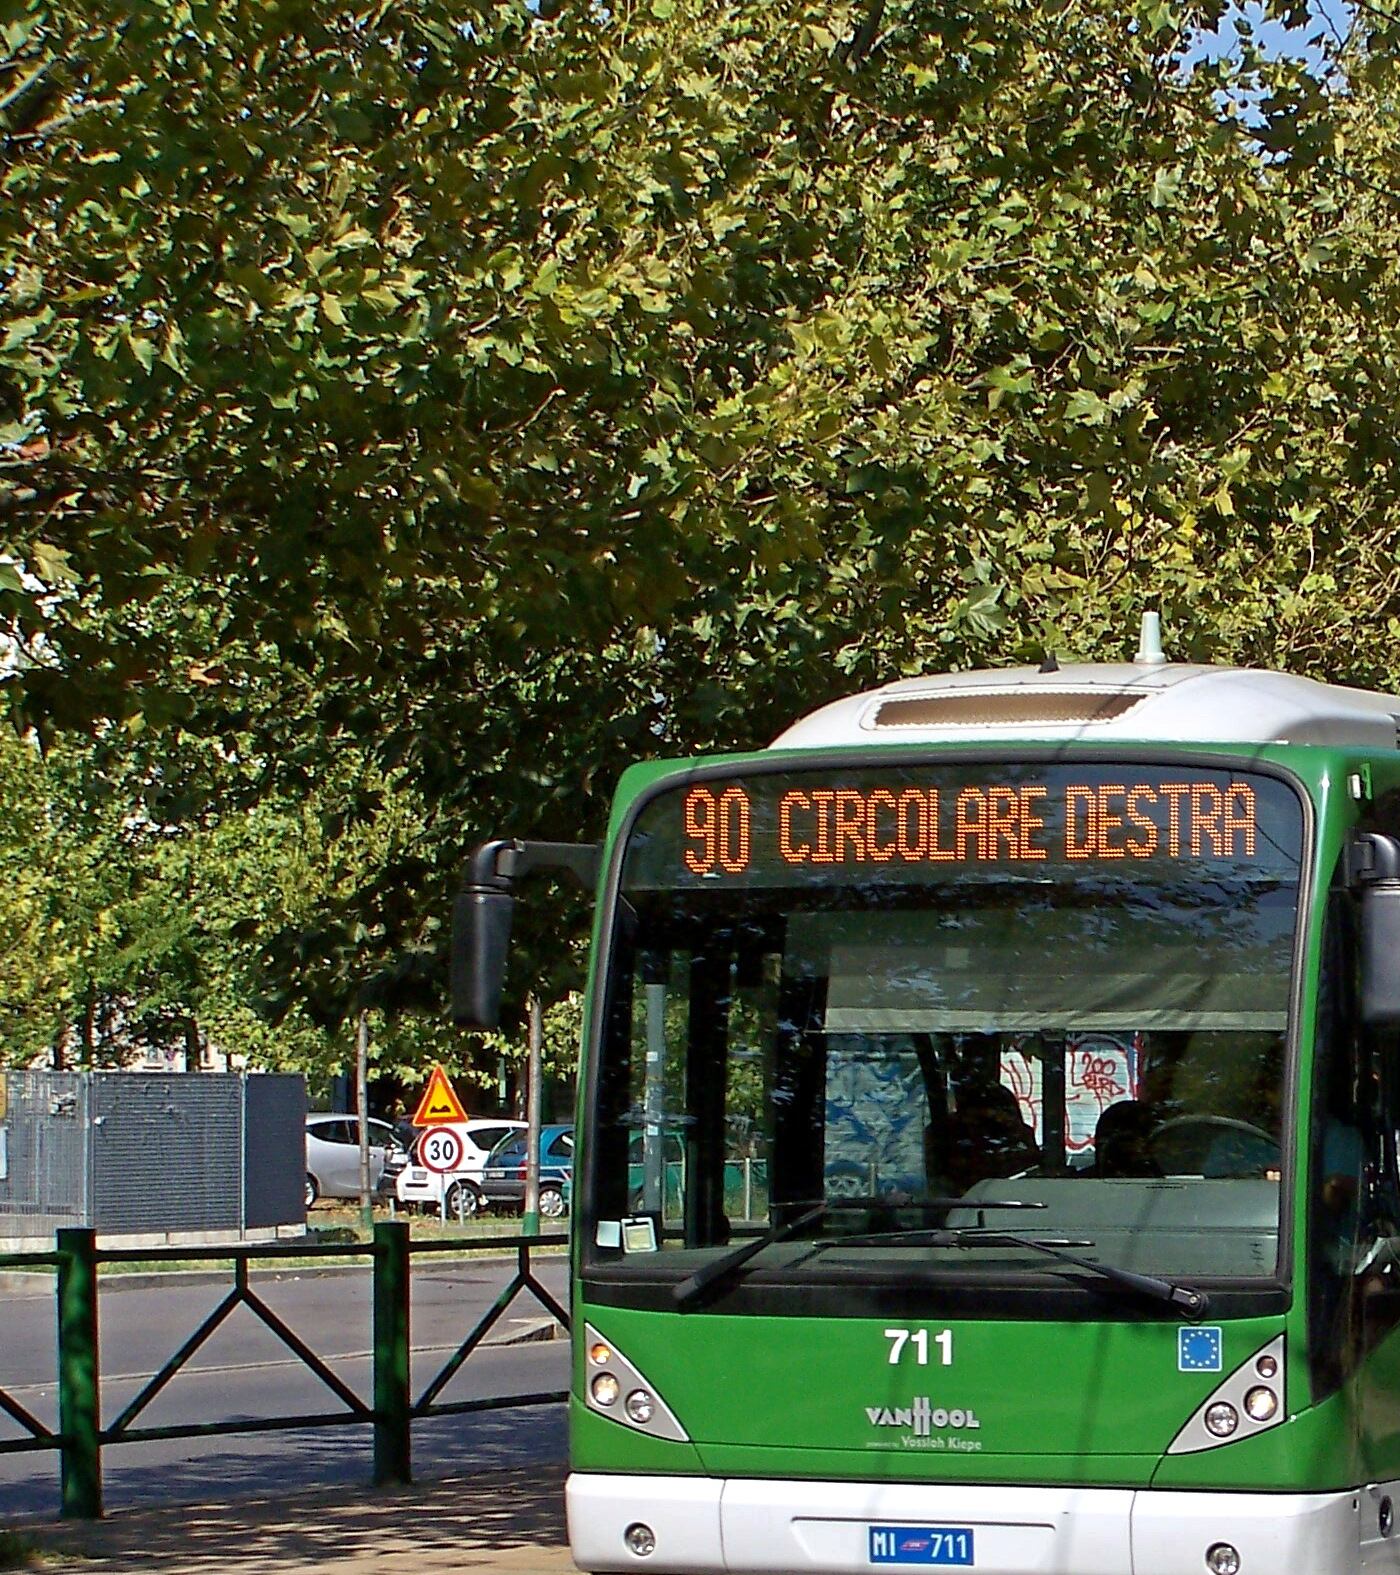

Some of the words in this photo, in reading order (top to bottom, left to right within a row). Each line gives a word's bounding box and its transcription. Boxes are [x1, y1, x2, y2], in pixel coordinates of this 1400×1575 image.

[685, 788, 750, 873] 90
[779, 786, 1047, 863] CIRCOLARE
[1065, 783, 1256, 858] DESTRA
[430, 1140, 454, 1161] 30
[884, 1328, 952, 1365] 711
[873, 1532, 896, 1557] MI
[930, 1533, 967, 1558] 711
